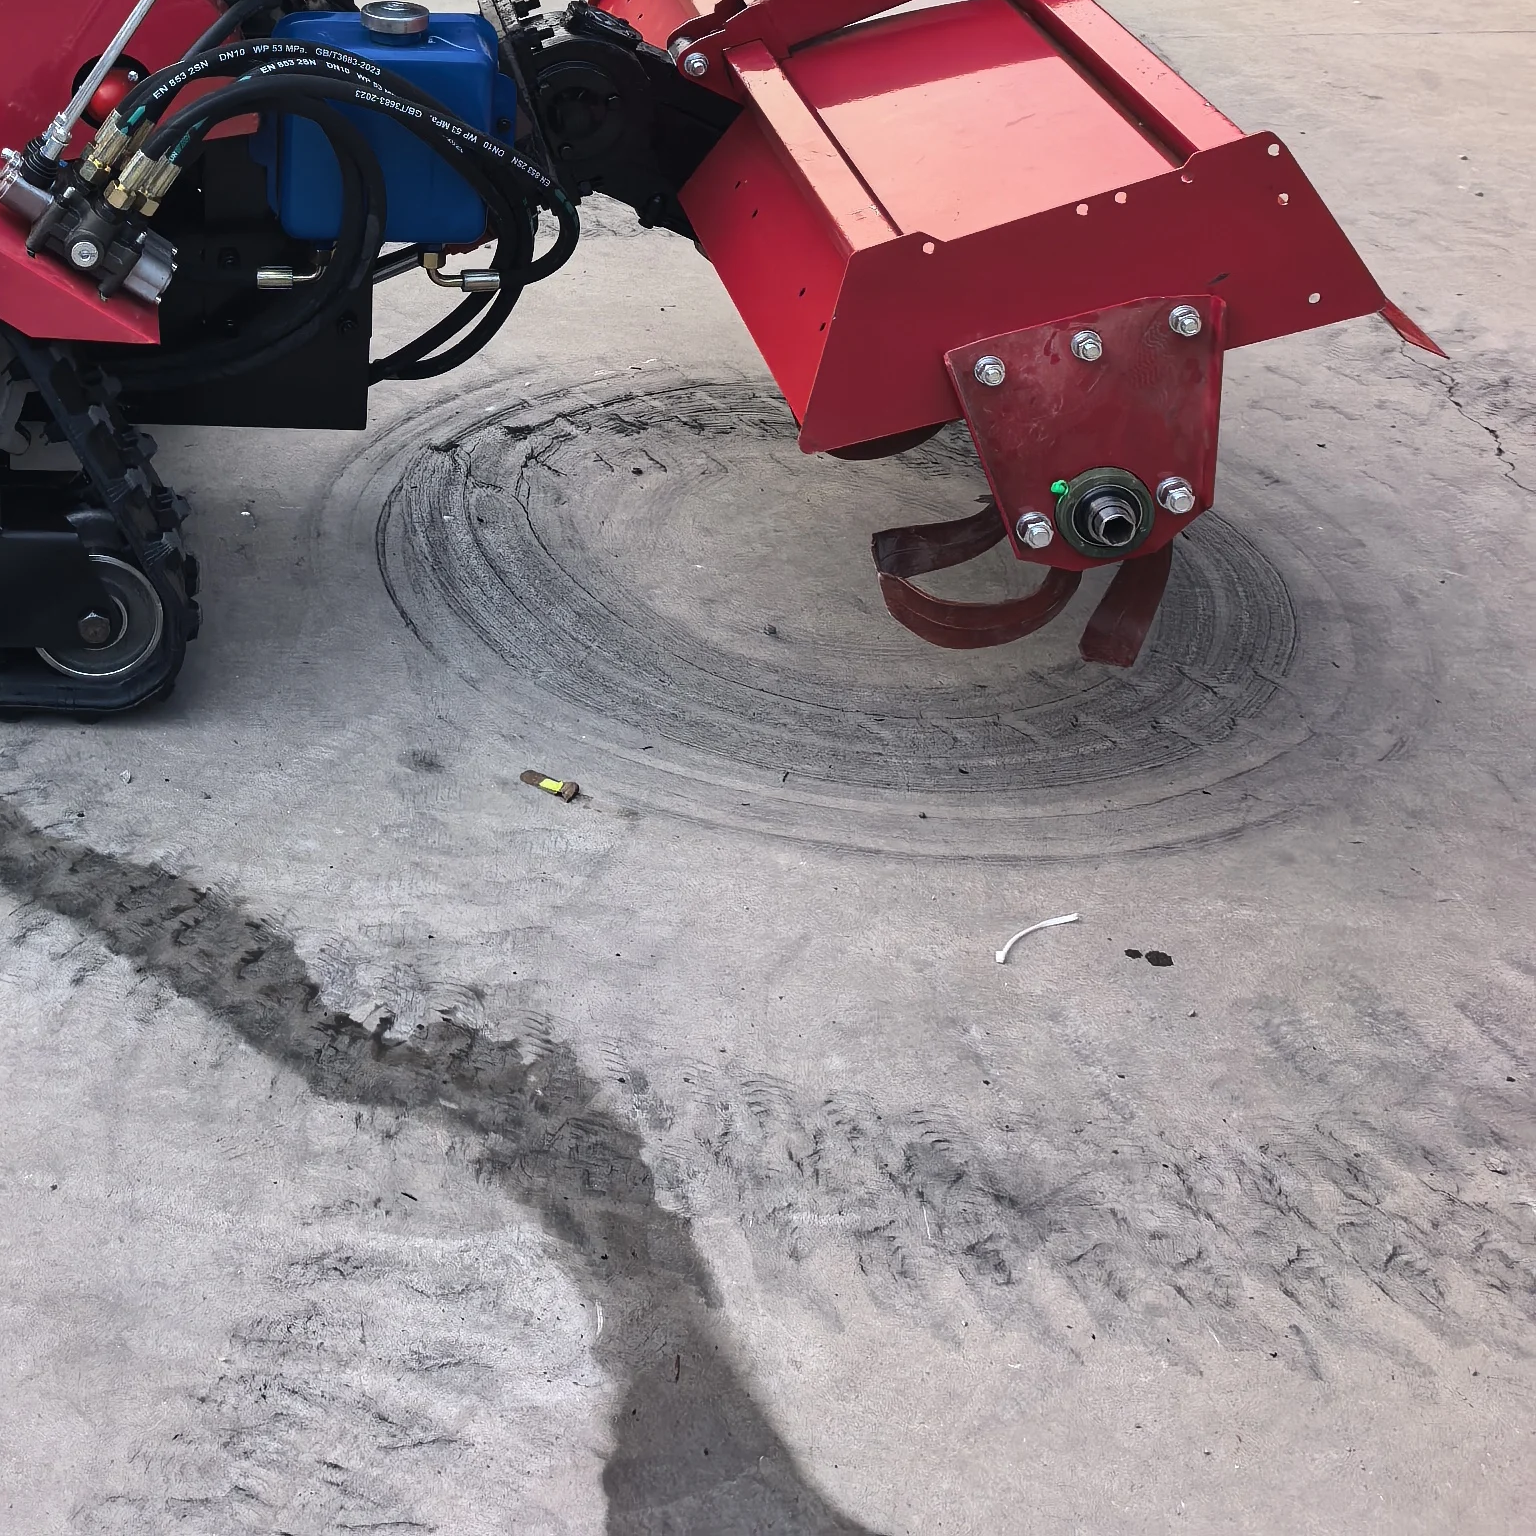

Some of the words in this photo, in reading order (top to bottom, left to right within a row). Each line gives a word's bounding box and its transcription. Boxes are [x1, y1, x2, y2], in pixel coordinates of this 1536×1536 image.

[153, 85, 168, 100] EN
[168, 72, 187, 87] 853
[187, 59, 209, 76] 2SN
[219, 48, 246, 62] DN10
[253, 44, 270, 54] WP
[272, 44, 283, 52] 53
[259, 62, 276, 74] EN
[355, 89, 423, 118] GB/T3683-2023
[451, 126, 463, 135] 53
[462, 132, 478, 144] WP
[483, 141, 505, 157] DN10
[511, 156, 528, 170] 2SN
[526, 166, 541, 179] 853
[539, 176, 551, 187] EN
